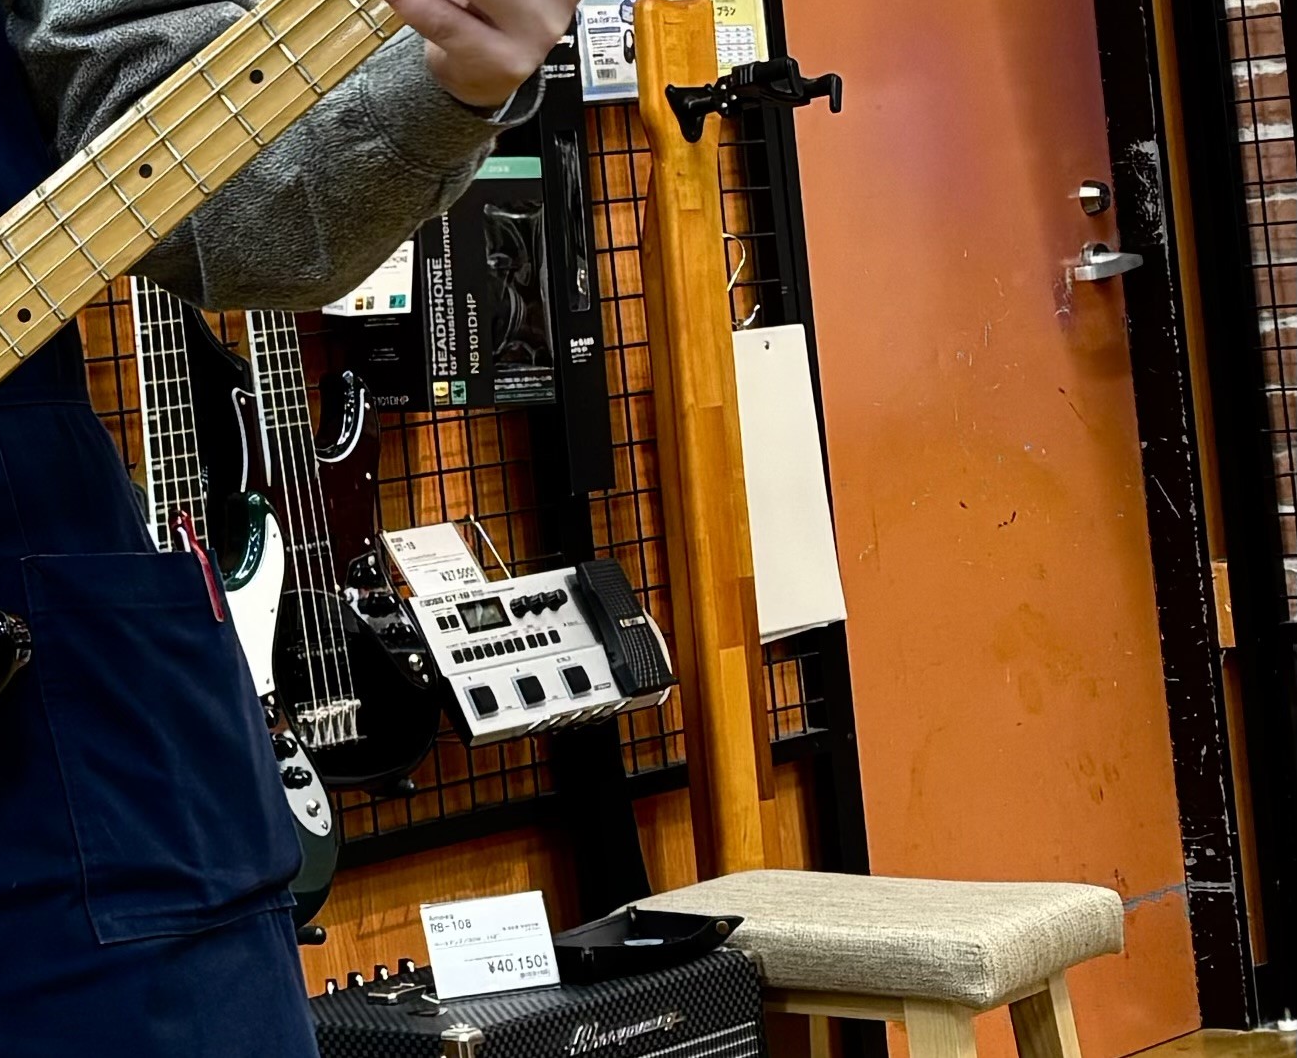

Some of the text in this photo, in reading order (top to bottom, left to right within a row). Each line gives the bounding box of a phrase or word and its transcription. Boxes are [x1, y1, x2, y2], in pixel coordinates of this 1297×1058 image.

[432, 257, 449, 376] HEADPHONE
[445, 294, 457, 351] musical
[448, 354, 458, 376] for
